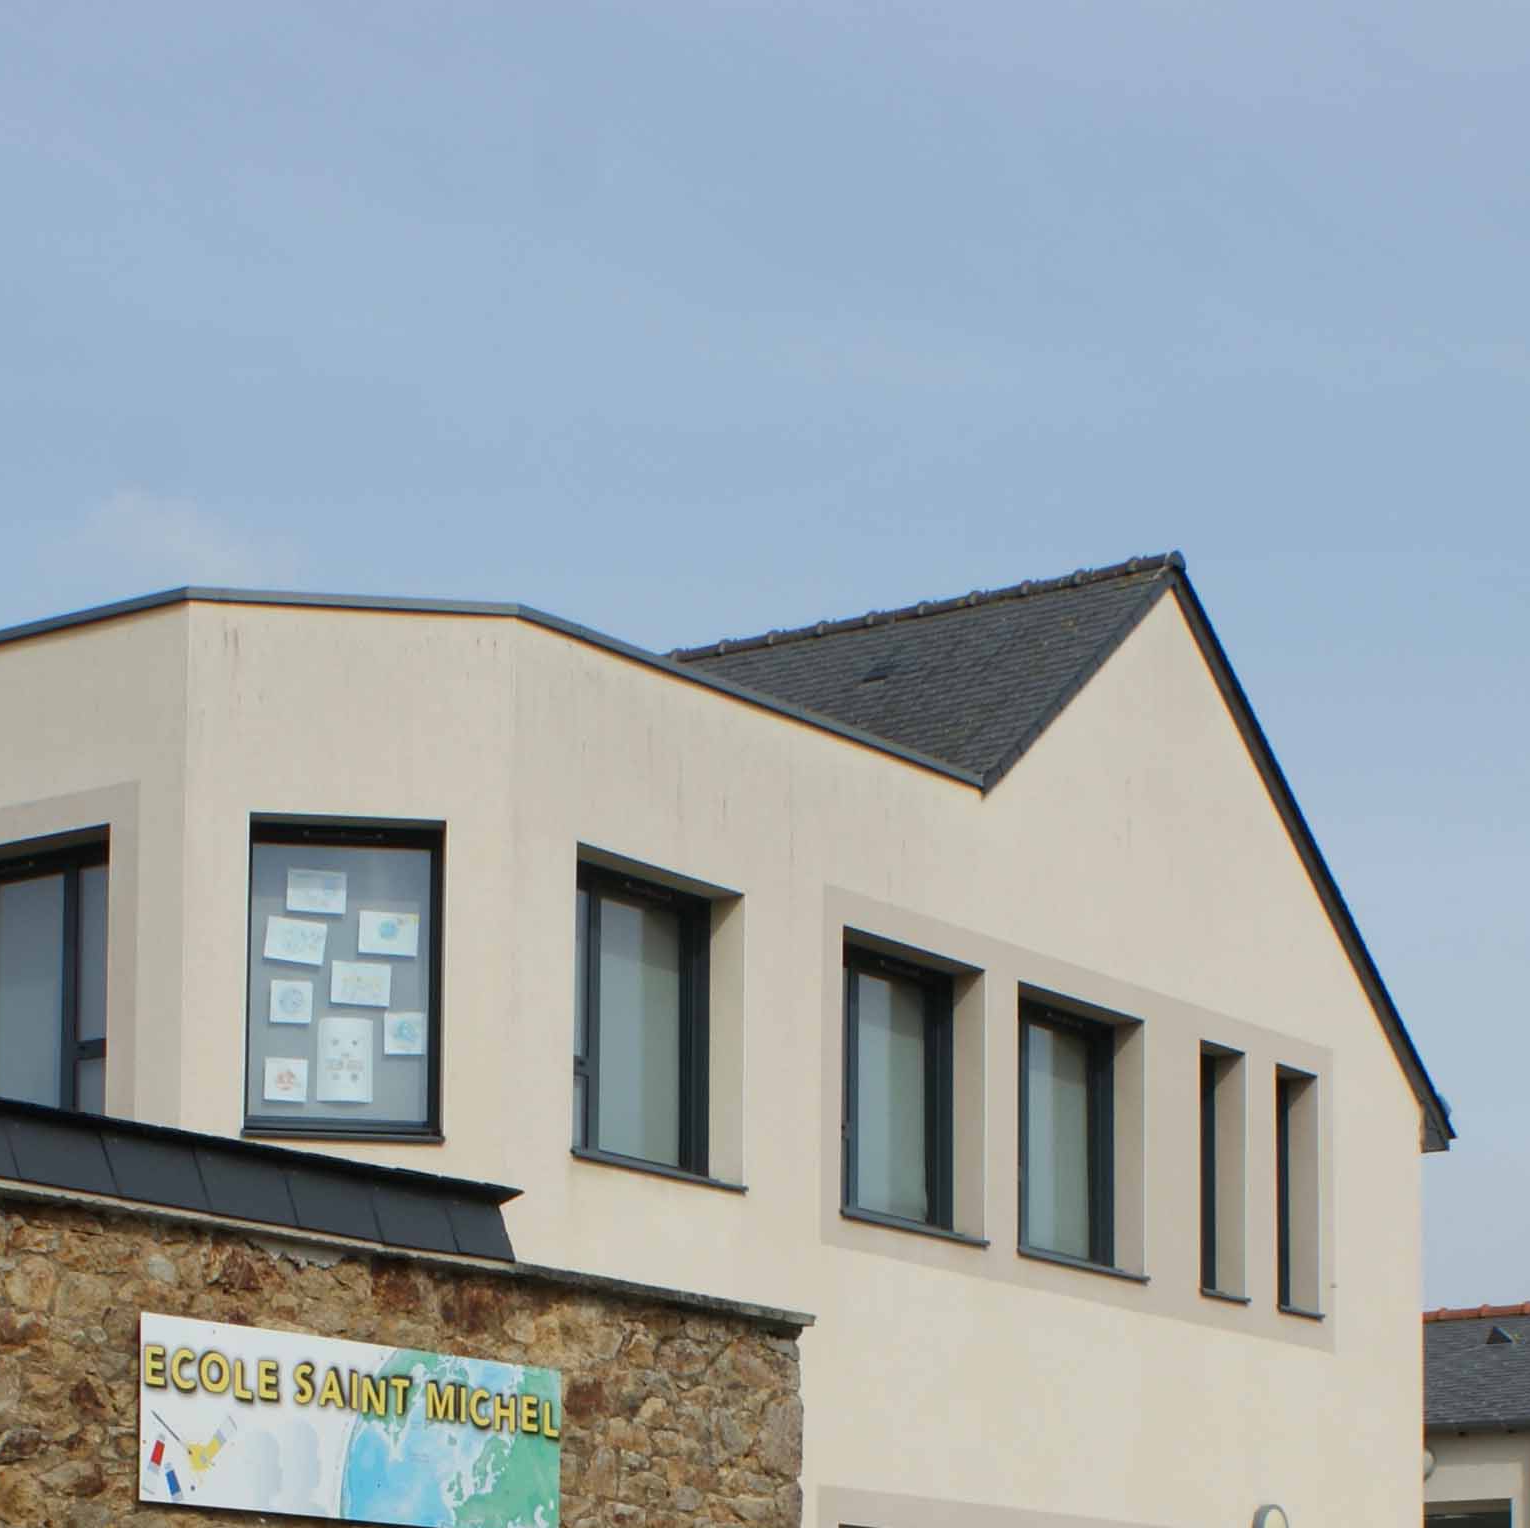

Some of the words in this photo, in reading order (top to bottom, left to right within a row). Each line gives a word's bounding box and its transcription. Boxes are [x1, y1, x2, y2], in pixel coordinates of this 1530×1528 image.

[144, 1344, 280, 1401] ECOLE
[293, 1363, 412, 1417] SAINT
[425, 1380, 560, 1439] MICHEL
